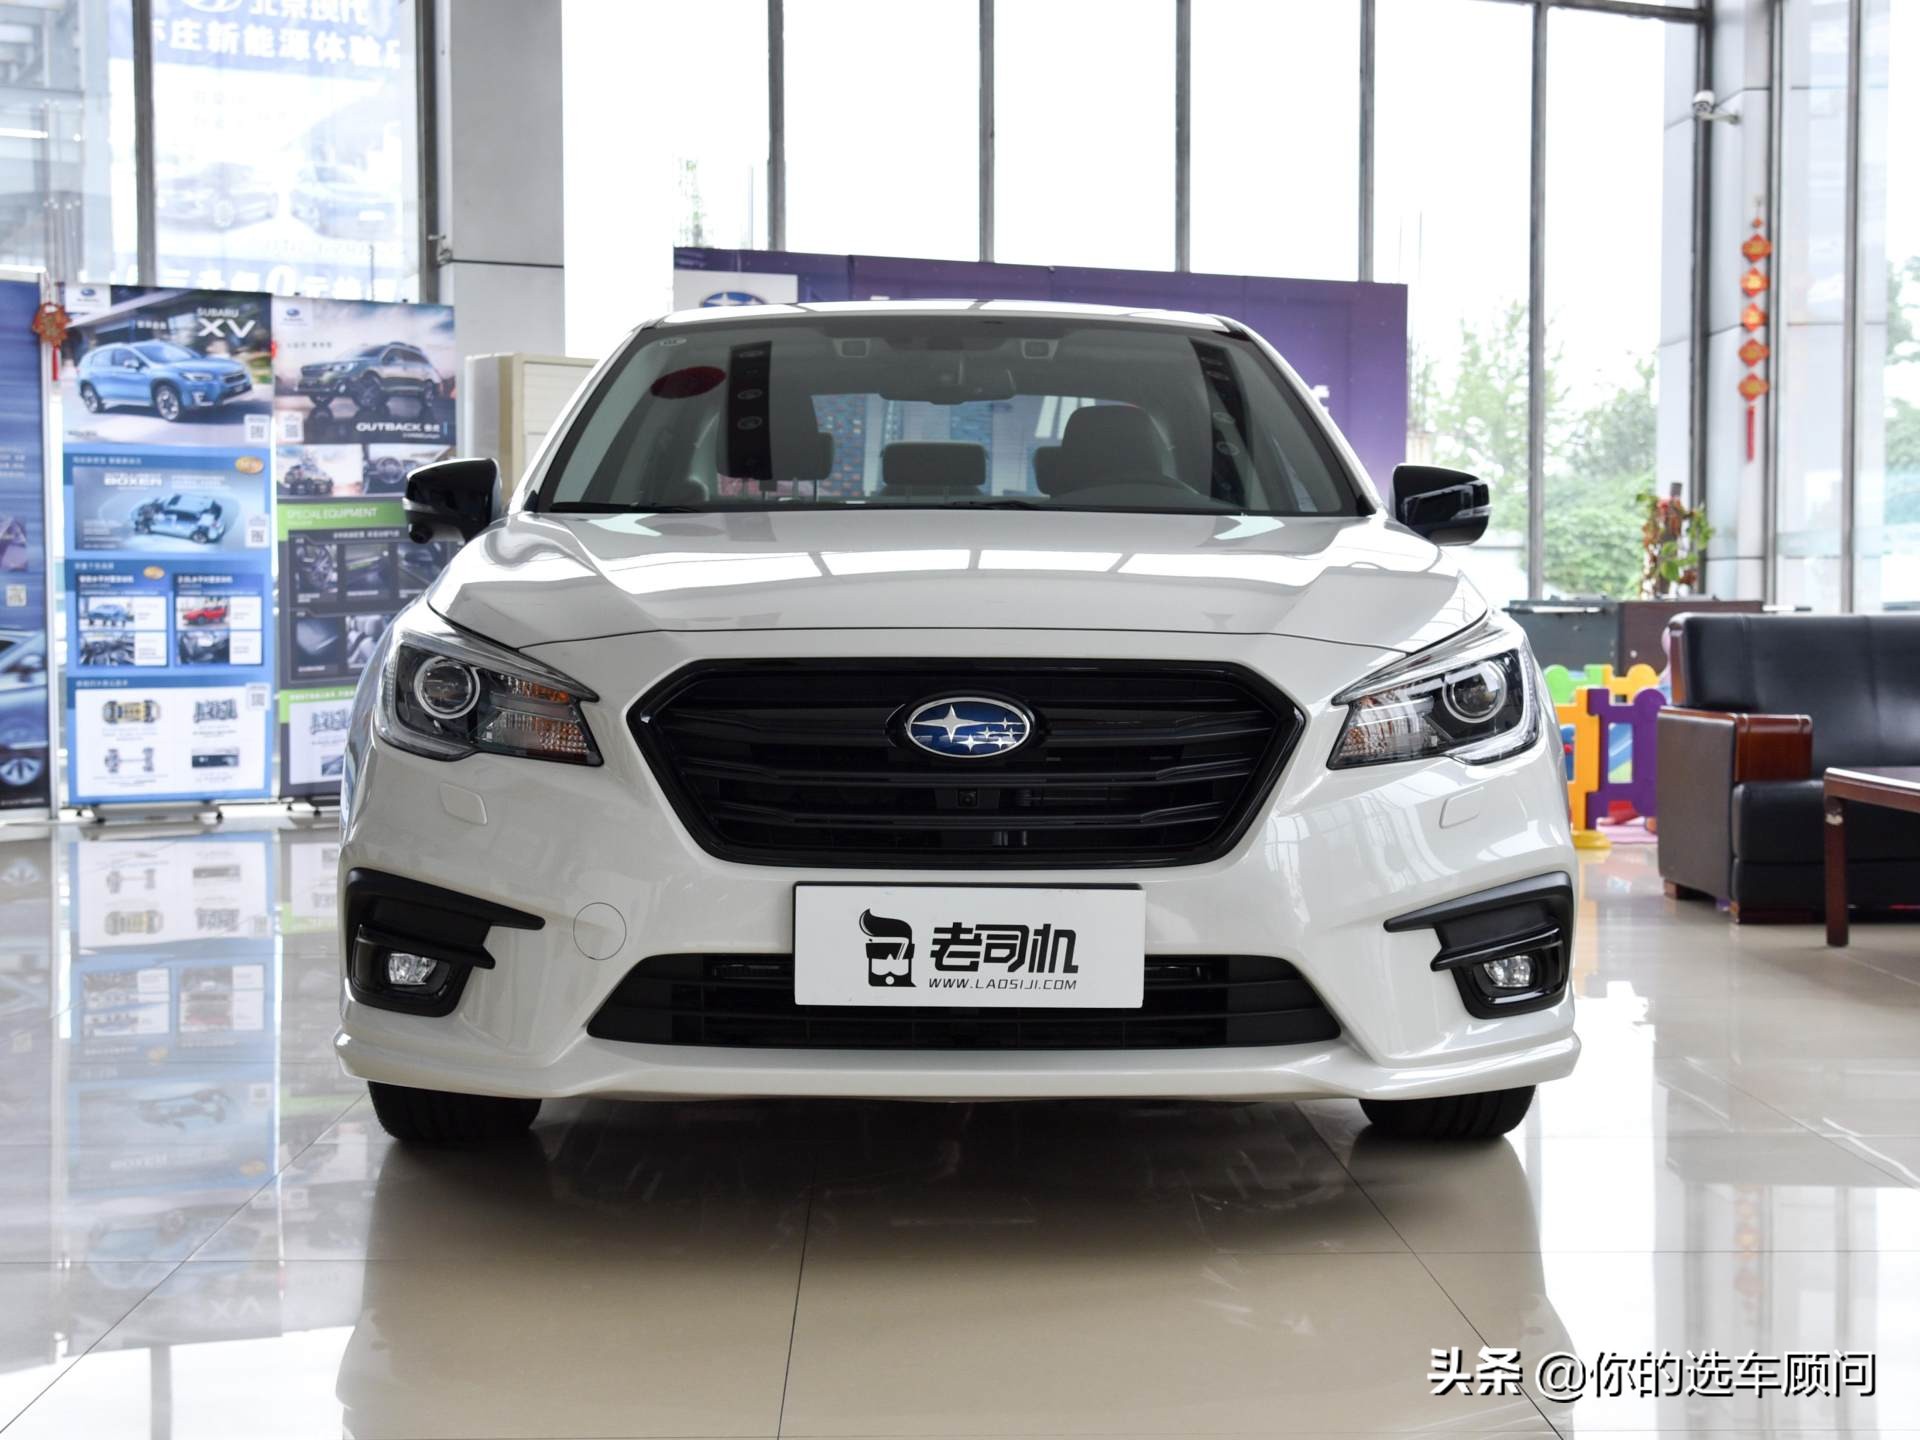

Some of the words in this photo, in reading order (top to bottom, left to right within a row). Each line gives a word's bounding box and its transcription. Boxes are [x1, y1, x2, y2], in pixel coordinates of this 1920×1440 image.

[197, 307, 240, 318] SUBARU
[198, 318, 256, 338] XV
[355, 422, 421, 432] OUTBACK
[930, 922, 1079, 974] 老司机
[928, 977, 1078, 990] WWW.LAOSIJI.COM
